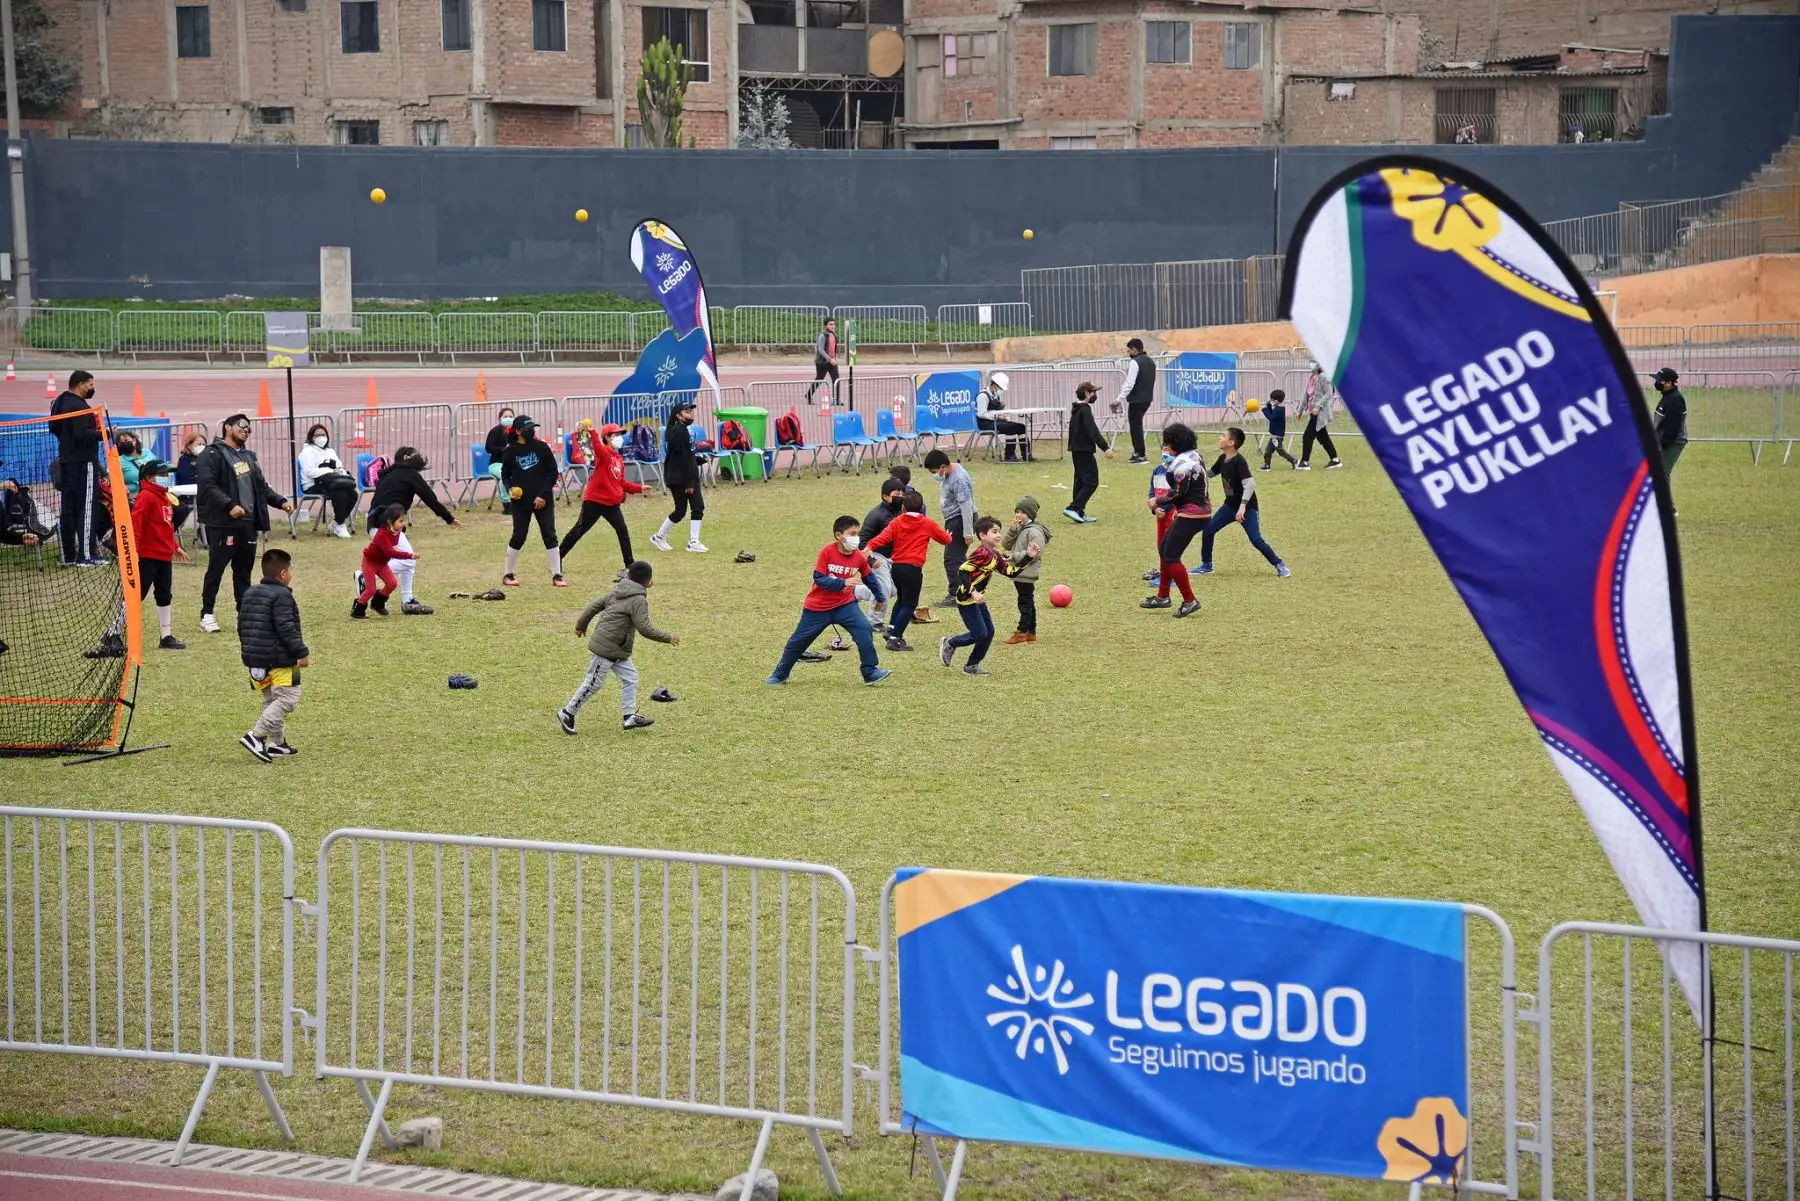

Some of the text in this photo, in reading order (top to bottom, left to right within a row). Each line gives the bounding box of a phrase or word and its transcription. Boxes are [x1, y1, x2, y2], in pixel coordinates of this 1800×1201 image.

[1379, 331, 1555, 435] LEGADO
[1405, 383, 1541, 474] AYLLU
[1421, 387, 1613, 509] PUKLLAY
[120, 525, 133, 576] CHAMPRO
[1109, 1036, 1367, 1087] Seguimos jugando
